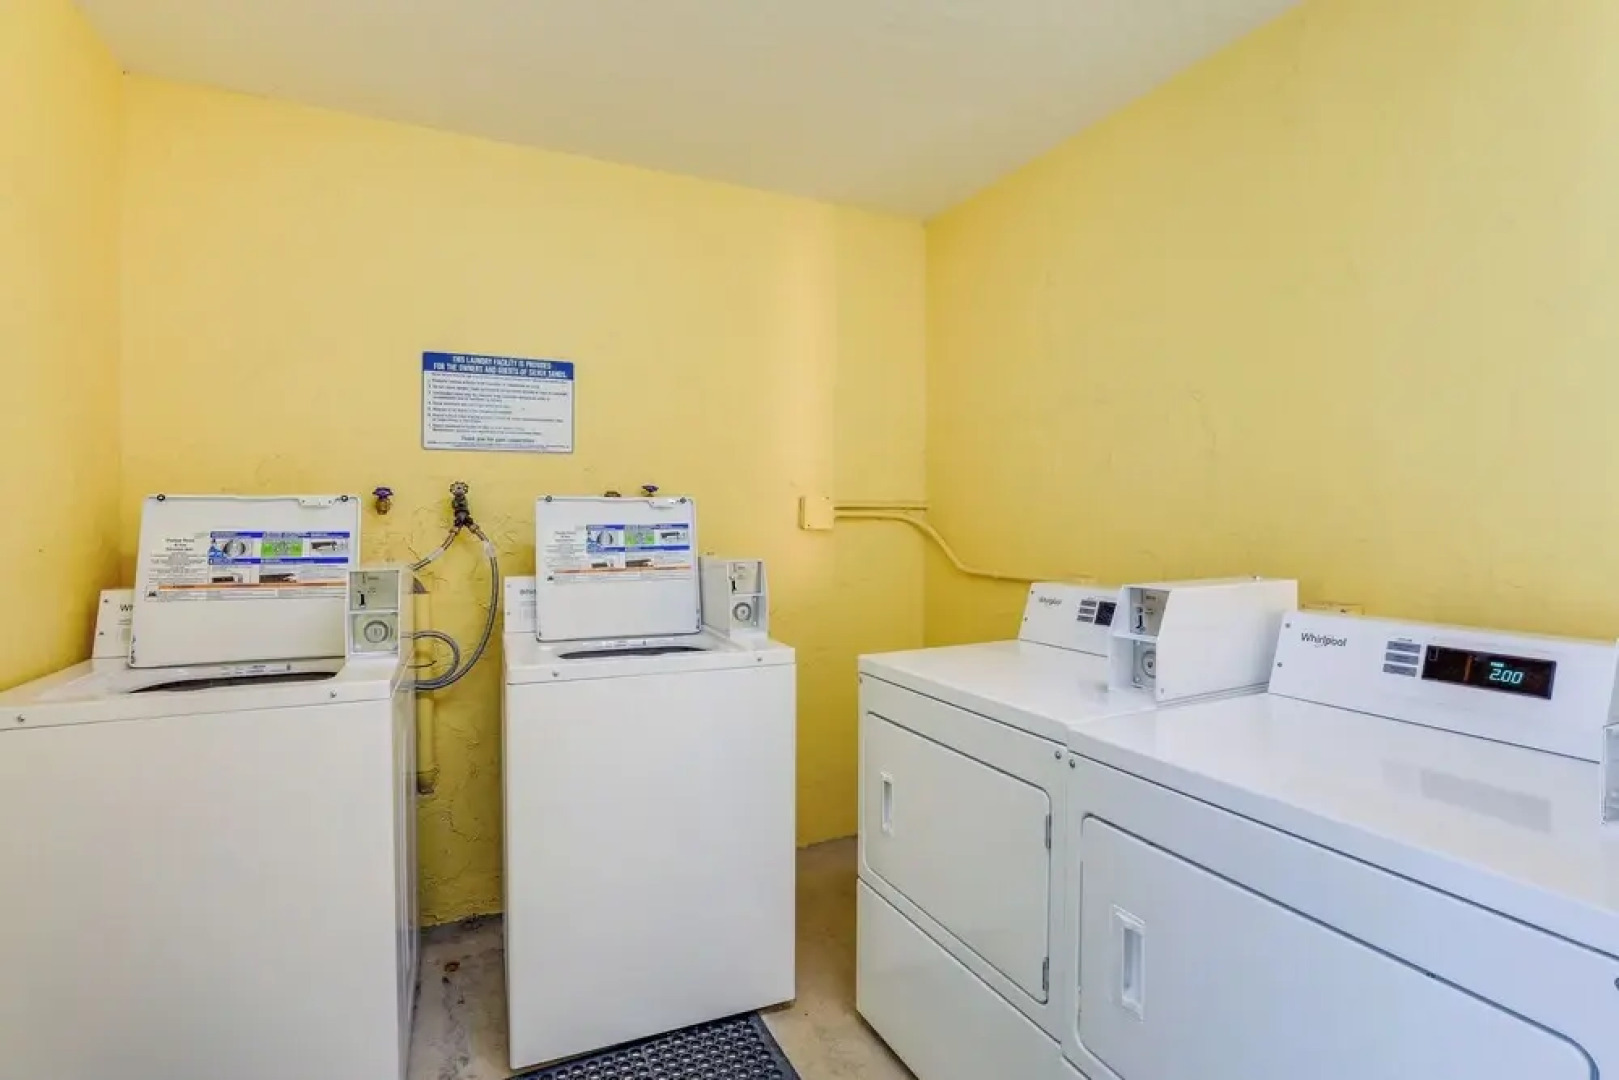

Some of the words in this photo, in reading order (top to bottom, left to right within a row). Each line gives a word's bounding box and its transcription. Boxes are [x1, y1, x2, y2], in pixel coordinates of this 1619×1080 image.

[433, 362, 445, 370] FOR
[446, 363, 458, 371] THE
[459, 364, 483, 372] OWNERS
[485, 366, 497, 374] AND
[498, 367, 518, 375] GUESTS
[519, 368, 527, 376] OF
[452, 356, 466, 364] THIS
[466, 356, 493, 365] LAUNDRY
[493, 358, 518, 367] FACILITY
[518, 360, 525, 368] IS
[526, 361, 552, 370] PROVIDED
[1301, 632, 1347, 647] Whirlpool
[1489, 668, 1525, 684] 2.00
